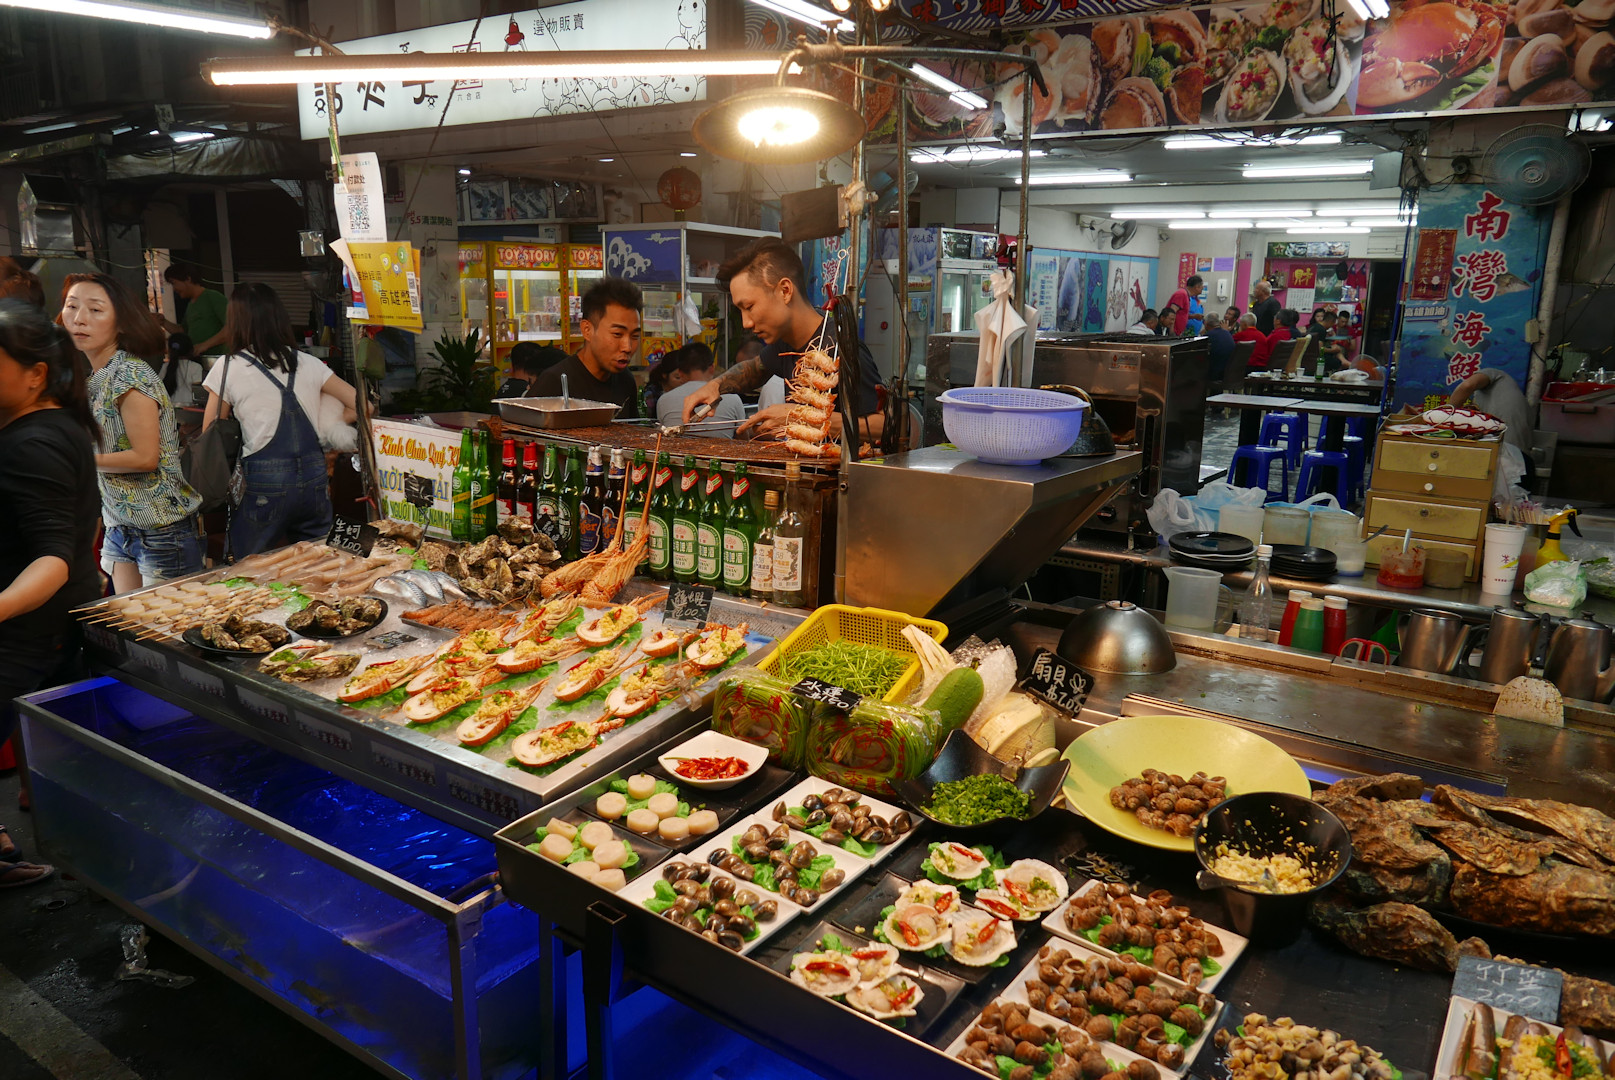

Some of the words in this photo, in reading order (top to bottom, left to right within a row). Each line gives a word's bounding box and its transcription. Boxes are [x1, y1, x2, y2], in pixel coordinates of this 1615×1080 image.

[533, 13, 584, 36] 選物販賣
[456, 91, 481, 102] 六合店
[497, 247, 520, 260] TOY
[522, 248, 556, 262] STORY
[571, 248, 590, 261] TOY
[1447, 191, 1510, 386] 南灣海鮮
[1404, 306, 1446, 317] 高雄加油
[335, 518, 361, 540] 生蚵
[1031, 652, 1067, 688] 扇貝
[1046, 684, 1082, 713] $200
[1477, 988, 1542, 1009] 200
